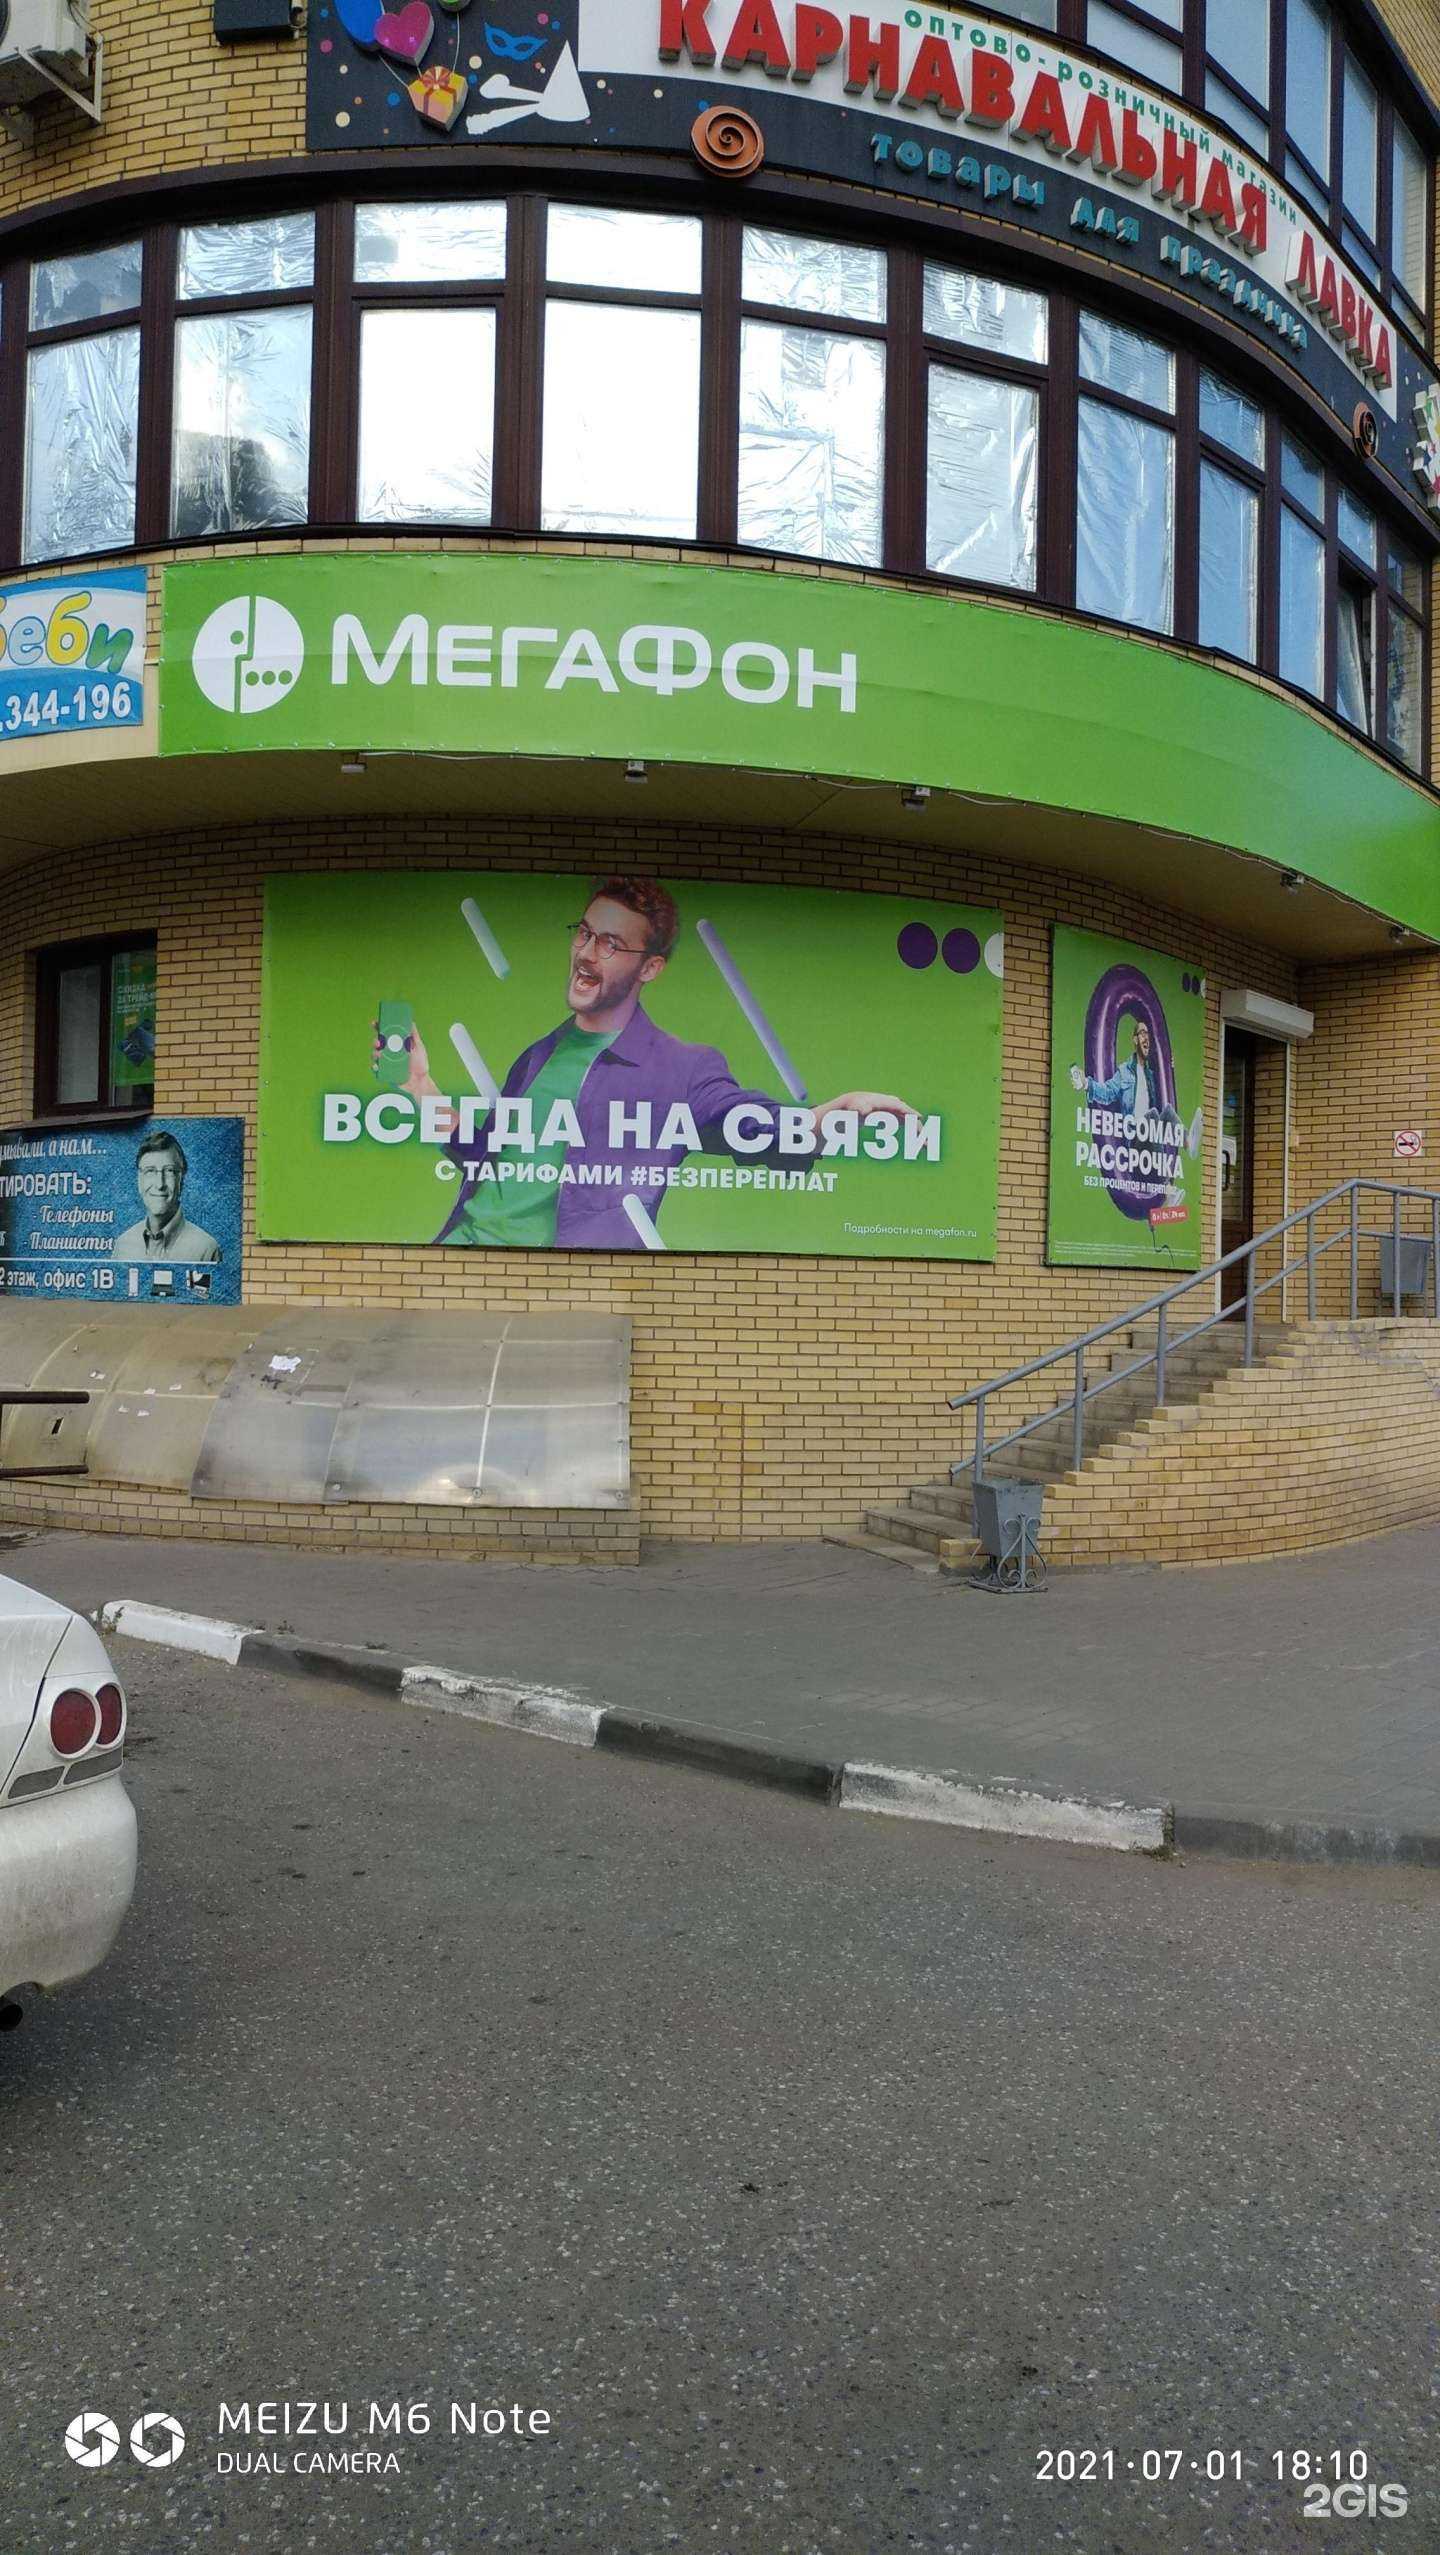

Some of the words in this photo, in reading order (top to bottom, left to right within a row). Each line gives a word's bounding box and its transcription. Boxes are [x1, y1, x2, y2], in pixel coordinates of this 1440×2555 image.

[658, 0, 1268, 256] КАРНАВАЛЬНАЯ
[1287, 229, 1392, 390] ЛАВКА
[1221, 148, 1297, 226] магазин
[871, 132, 1046, 207] товары
[1070, 196, 1139, 245] для
[1160, 234, 1308, 351] праздника
[0, 590, 135, 674] еби
[323, 1093, 585, 1154] ВСЕГДА
[608, 1100, 703, 1151] НА
[722, 1103, 941, 1162] СВЯЗИ
[1075, 1107, 1185, 1147] НЕВЕСОМАЯ
[435, 1160, 456, 1181] С
[463, 1160, 623, 1186] ТАРИФАМИ
[630, 1165, 839, 1193] #БЕЗПЕРЕПЛАТ
[1075, 1141, 1185, 1180] РАССРОЧКА
[1084, 1175, 1099, 1187] БЕЗ
[40, 1205, 114, 1228] Телефоны
[843, 1222, 909, 1236] Подробности
[911, 1227, 923, 1236] на
[925, 1226, 977, 1239] megafon.ru
[30, 1231, 114, 1251] Планшеты
[44, 1267, 87, 1292] офис
